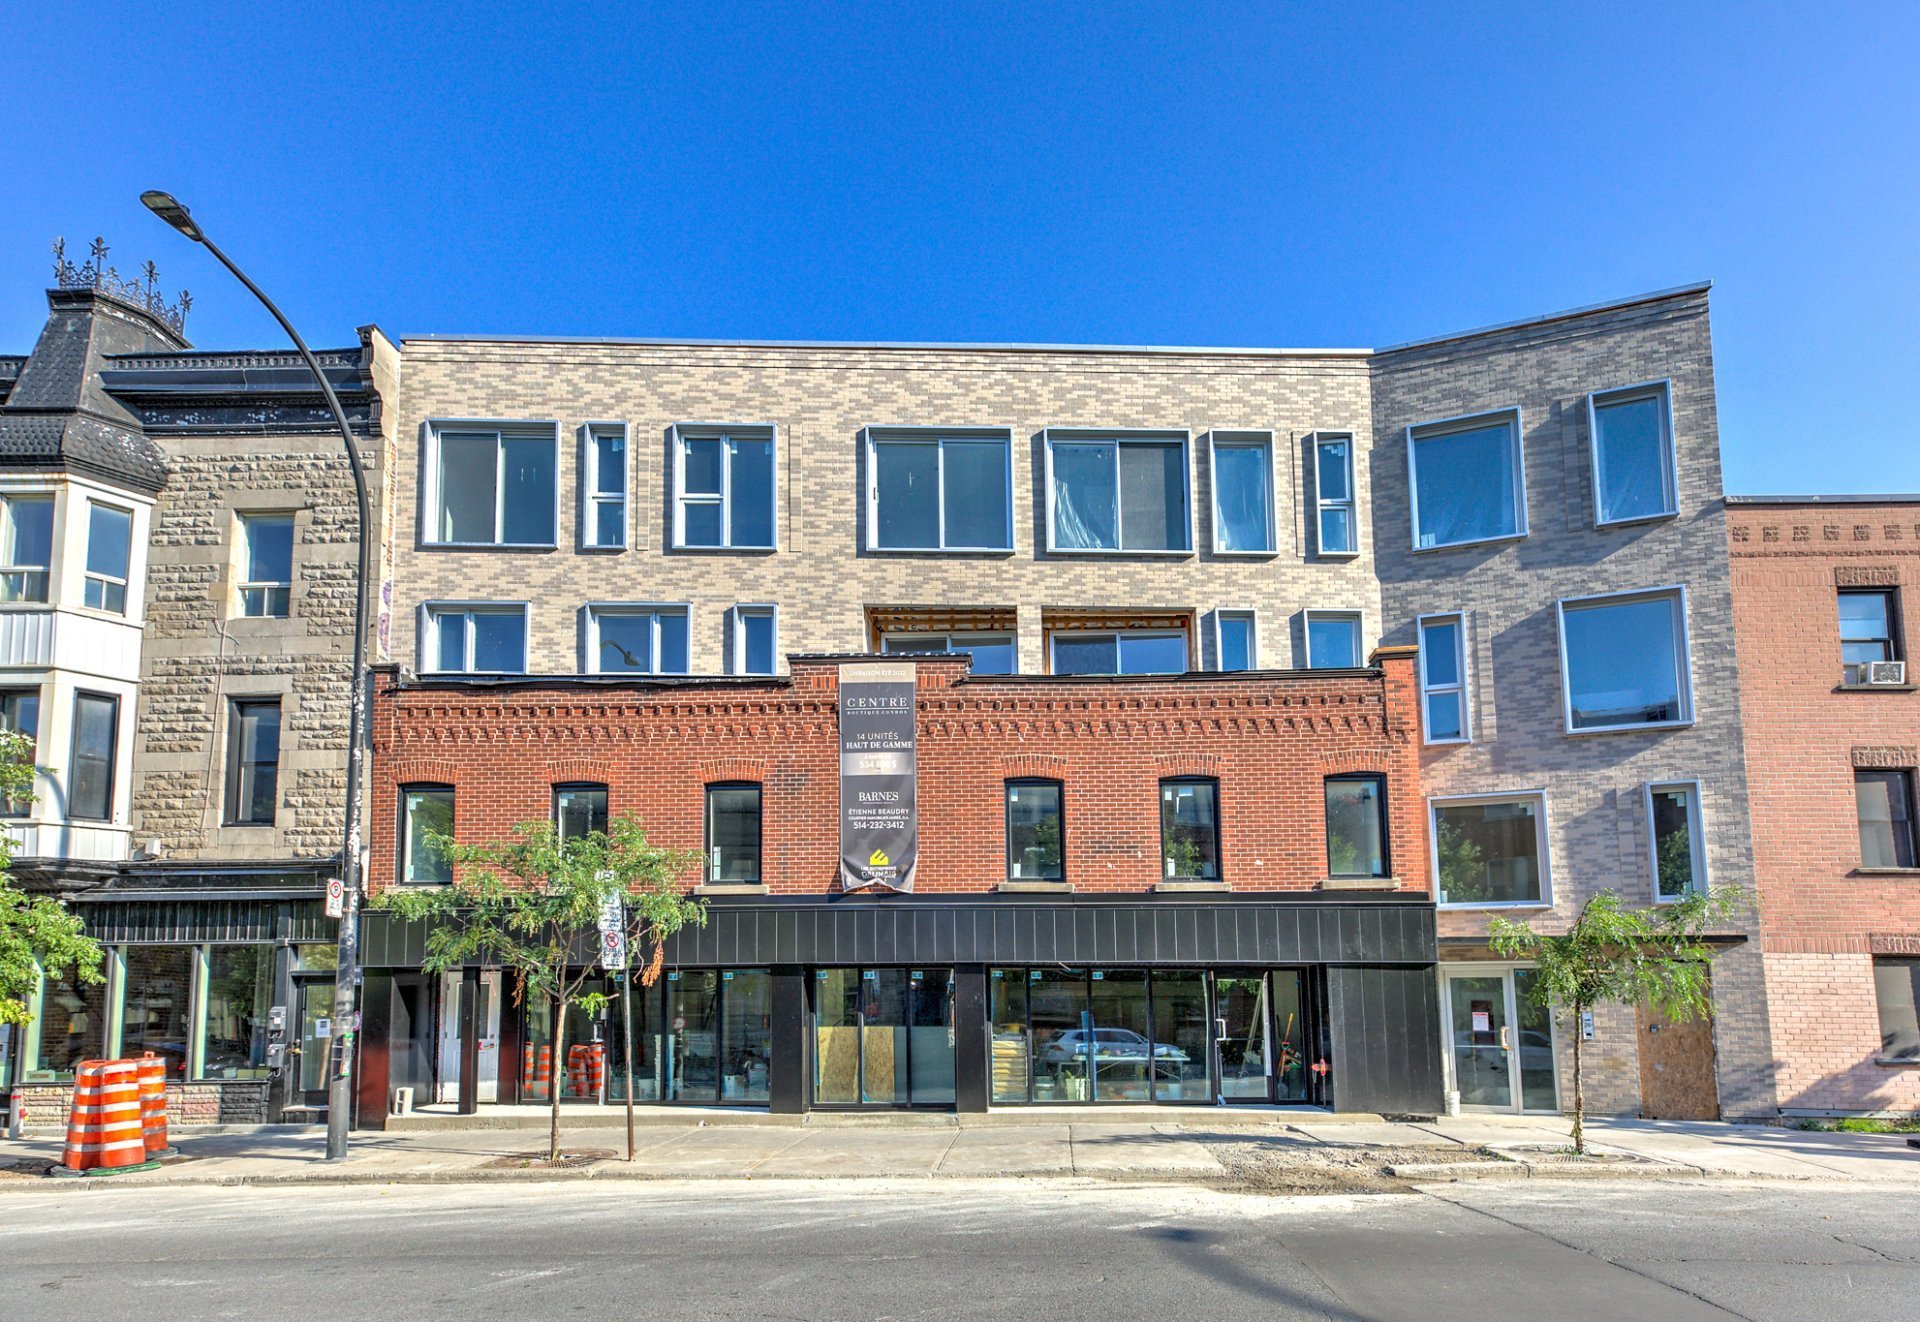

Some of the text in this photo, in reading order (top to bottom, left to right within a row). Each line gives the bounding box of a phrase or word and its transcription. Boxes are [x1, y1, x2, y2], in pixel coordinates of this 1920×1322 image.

[847, 697, 907, 707] CENTRE
[868, 731, 899, 740] UNITÉS
[882, 741, 913, 749] GAMME
[859, 791, 899, 801] BARNES
[853, 821, 905, 829] 514-232-3412
